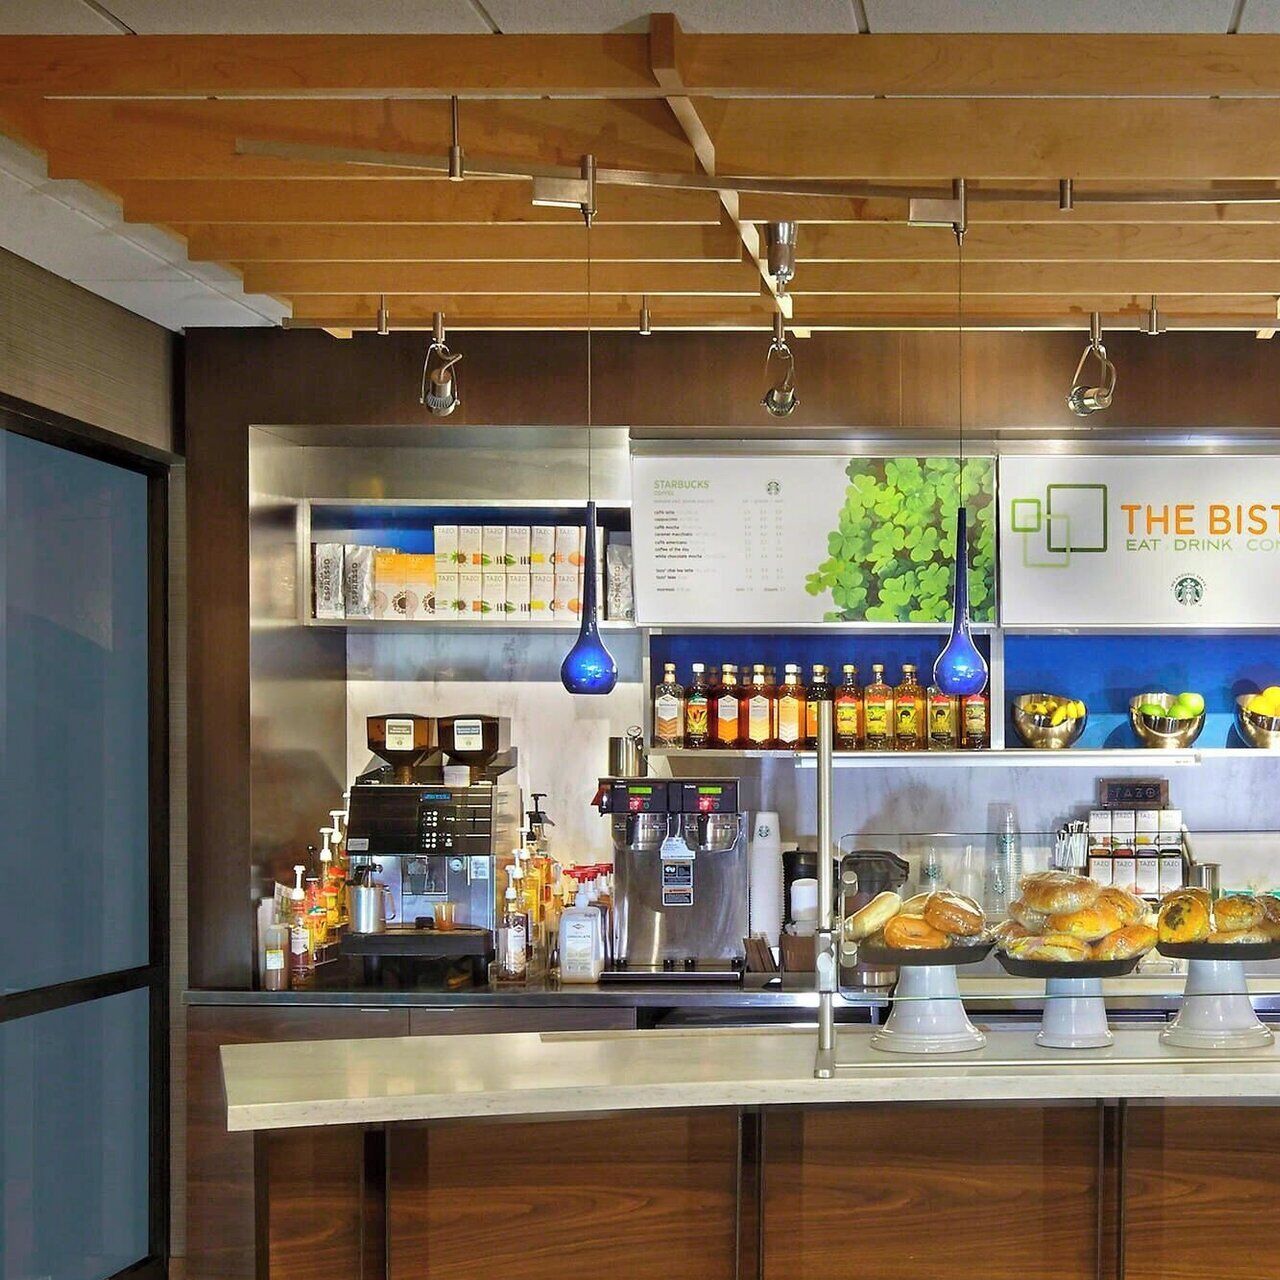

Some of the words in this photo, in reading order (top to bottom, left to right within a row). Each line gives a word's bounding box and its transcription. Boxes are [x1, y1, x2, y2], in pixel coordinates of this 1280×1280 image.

[653, 480, 710, 489] STARBUCKS
[1120, 504, 1195, 535] THE
[1126, 539, 1162, 551] EAT
[1174, 539, 1232, 551] DRINK
